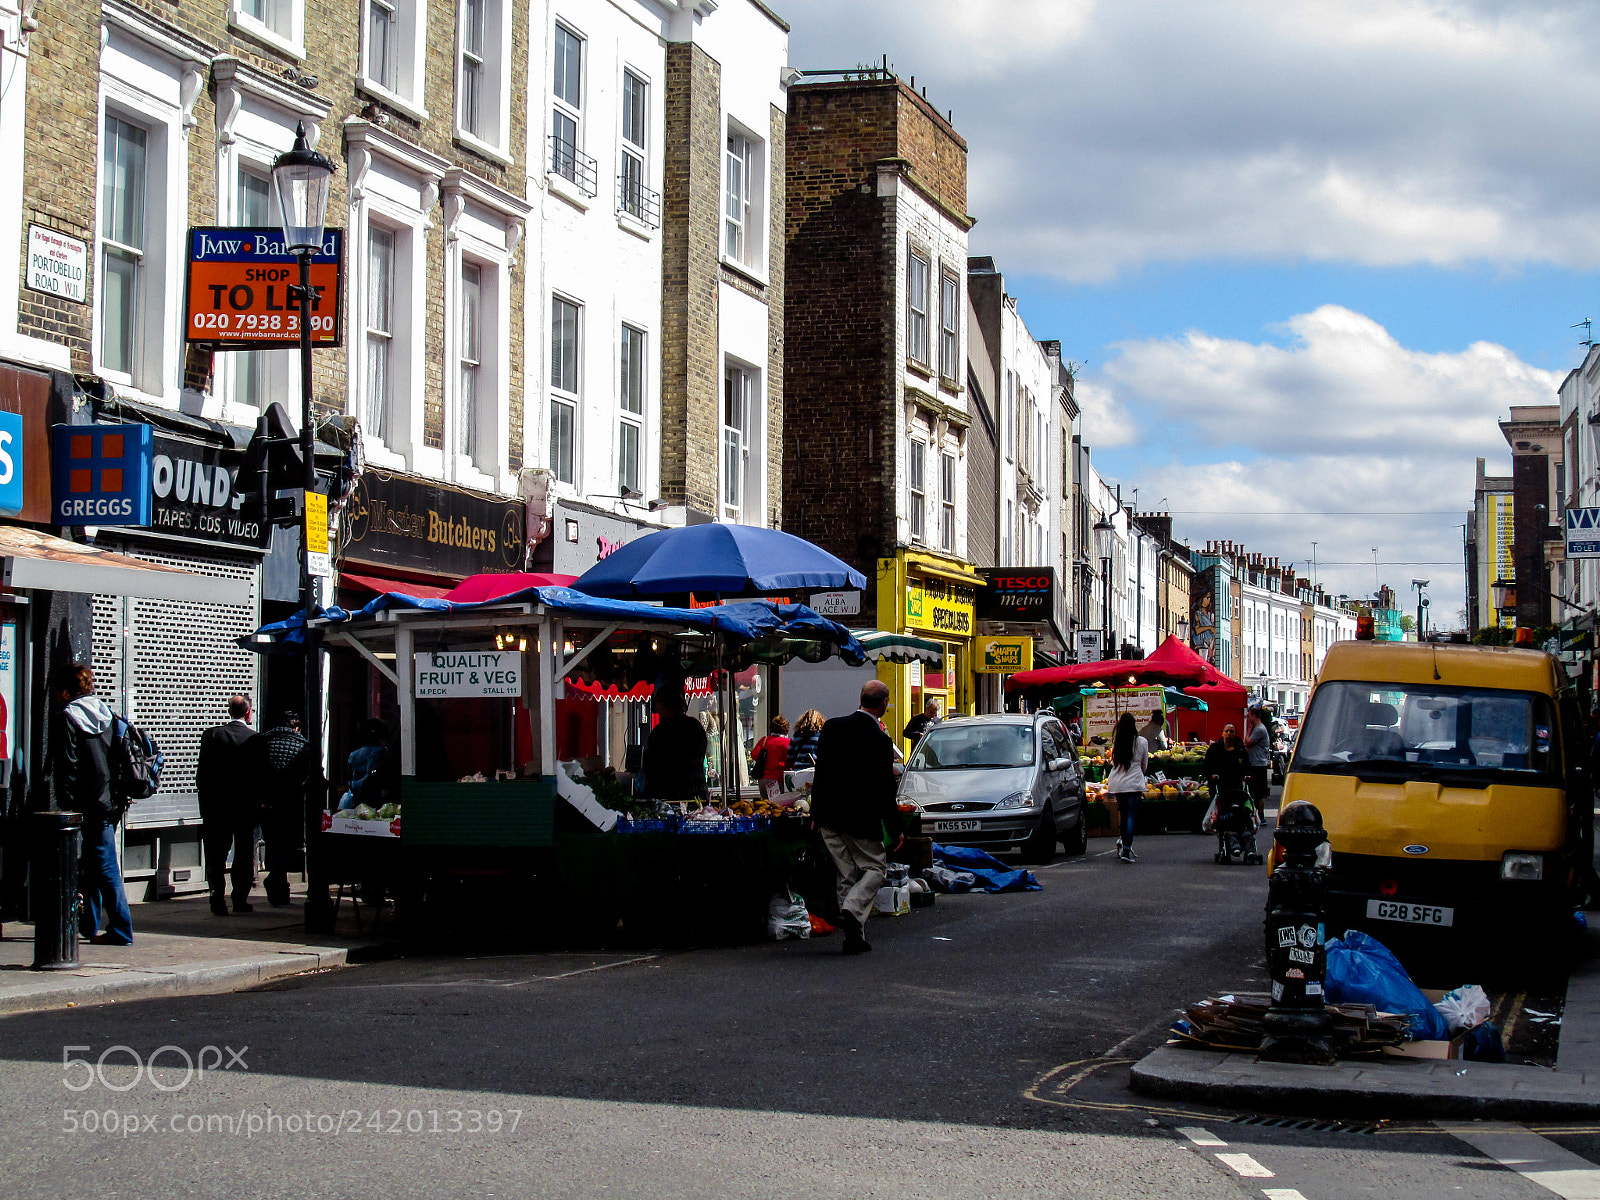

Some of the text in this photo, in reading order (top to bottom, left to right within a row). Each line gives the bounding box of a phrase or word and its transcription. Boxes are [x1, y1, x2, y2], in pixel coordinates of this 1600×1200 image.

[196, 234, 243, 259] JMW
[32, 253, 82, 281] PORTOBELLO
[245, 269, 290, 282] SHOP
[208, 284, 326, 312] TO LET
[193, 313, 334, 331] 020 7938 390
[60, 498, 132, 518] GREGGS
[370, 499, 496, 552] Master Butchers
[994, 576, 1050, 589] TESCO
[824, 598, 846, 606] ALBA
[1000, 594, 1043, 606] Metro
[990, 645, 1020, 657] SNAPPY
[434, 654, 501, 669] QUALITY
[994, 655, 1019, 665] SNAPS
[420, 670, 517, 685] FRUIT & VEG
[961, 821, 978, 830] SVP
[1378, 903, 1442, 923] G28 SFG
